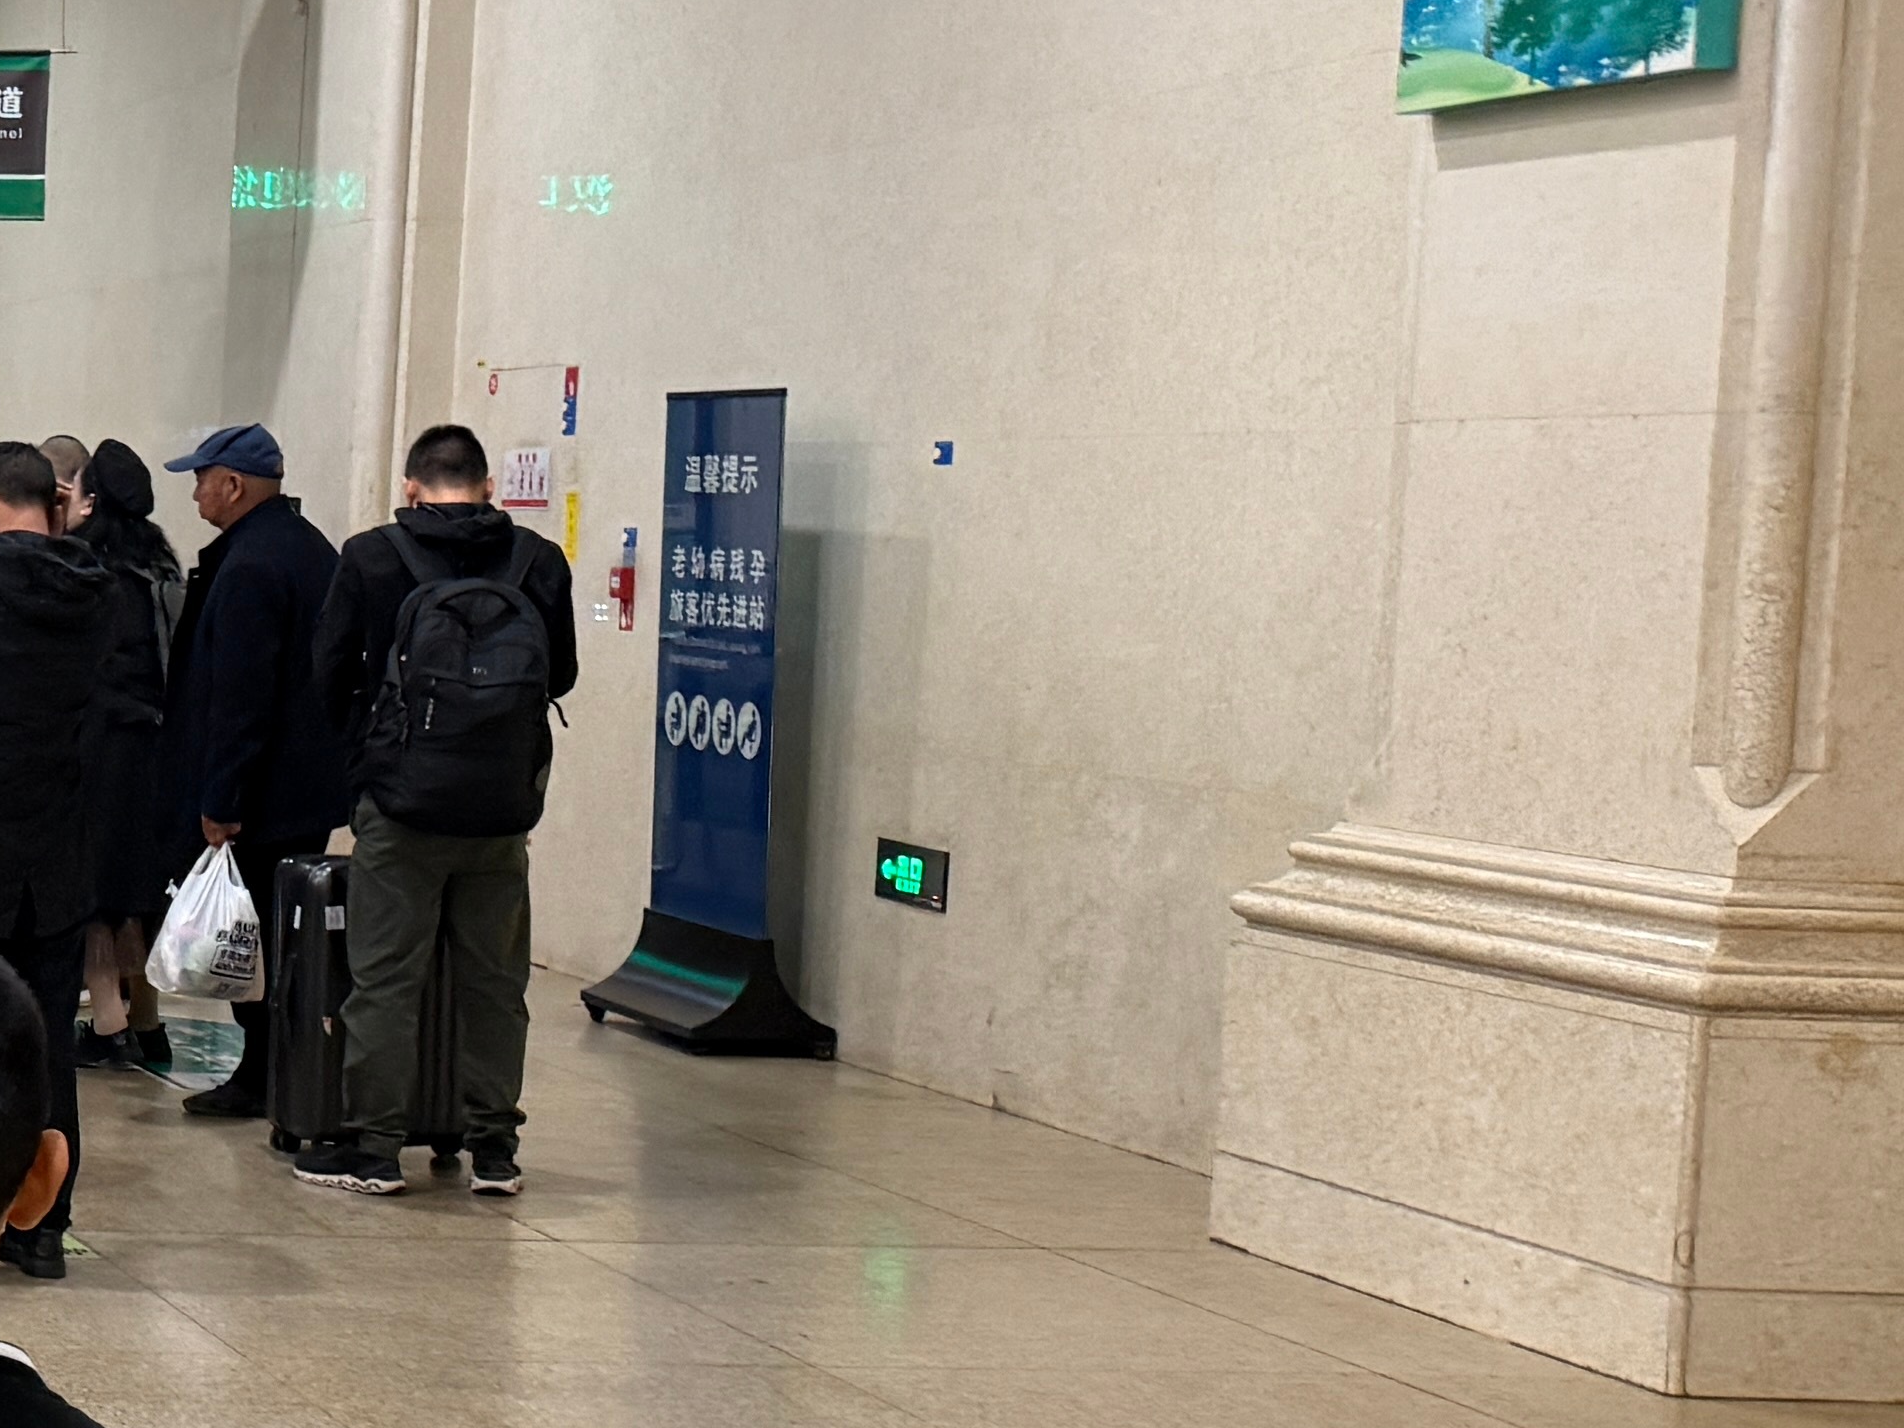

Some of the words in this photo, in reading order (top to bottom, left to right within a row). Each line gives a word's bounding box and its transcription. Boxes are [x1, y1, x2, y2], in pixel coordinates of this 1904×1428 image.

[685, 455, 759, 495] 温馨提示
[671, 544, 766, 585] 老幼病残孕
[669, 589, 765, 632] 旅客优先进站
